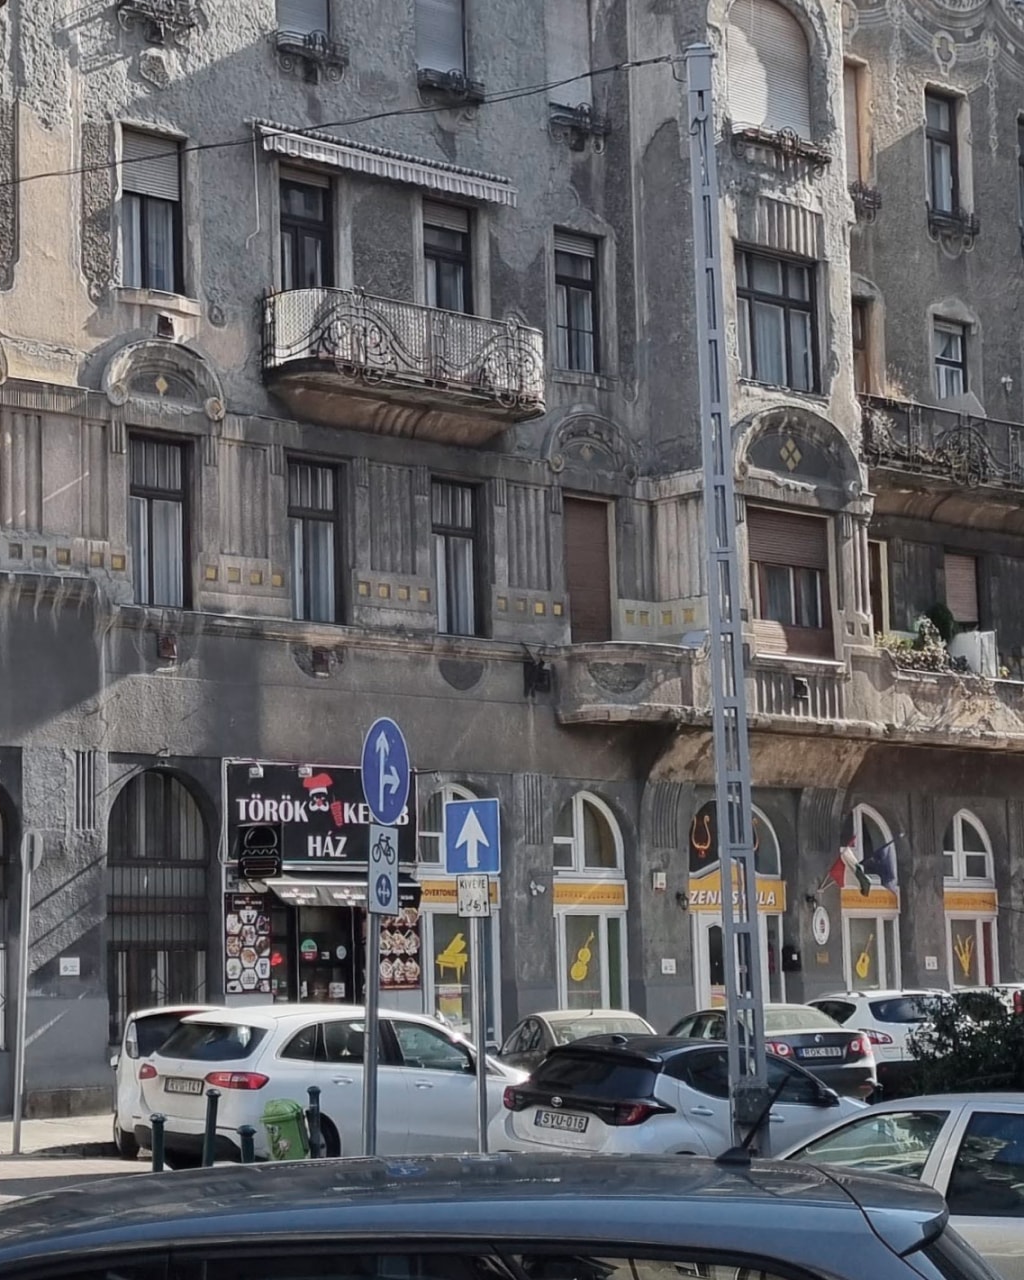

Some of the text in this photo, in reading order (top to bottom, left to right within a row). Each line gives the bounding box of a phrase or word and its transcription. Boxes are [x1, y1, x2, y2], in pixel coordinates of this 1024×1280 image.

[236, 793, 410, 825] TÖRÖK KEB
[307, 830, 348, 858] HÁZ
[542, 1112, 585, 1129] SYU-016
